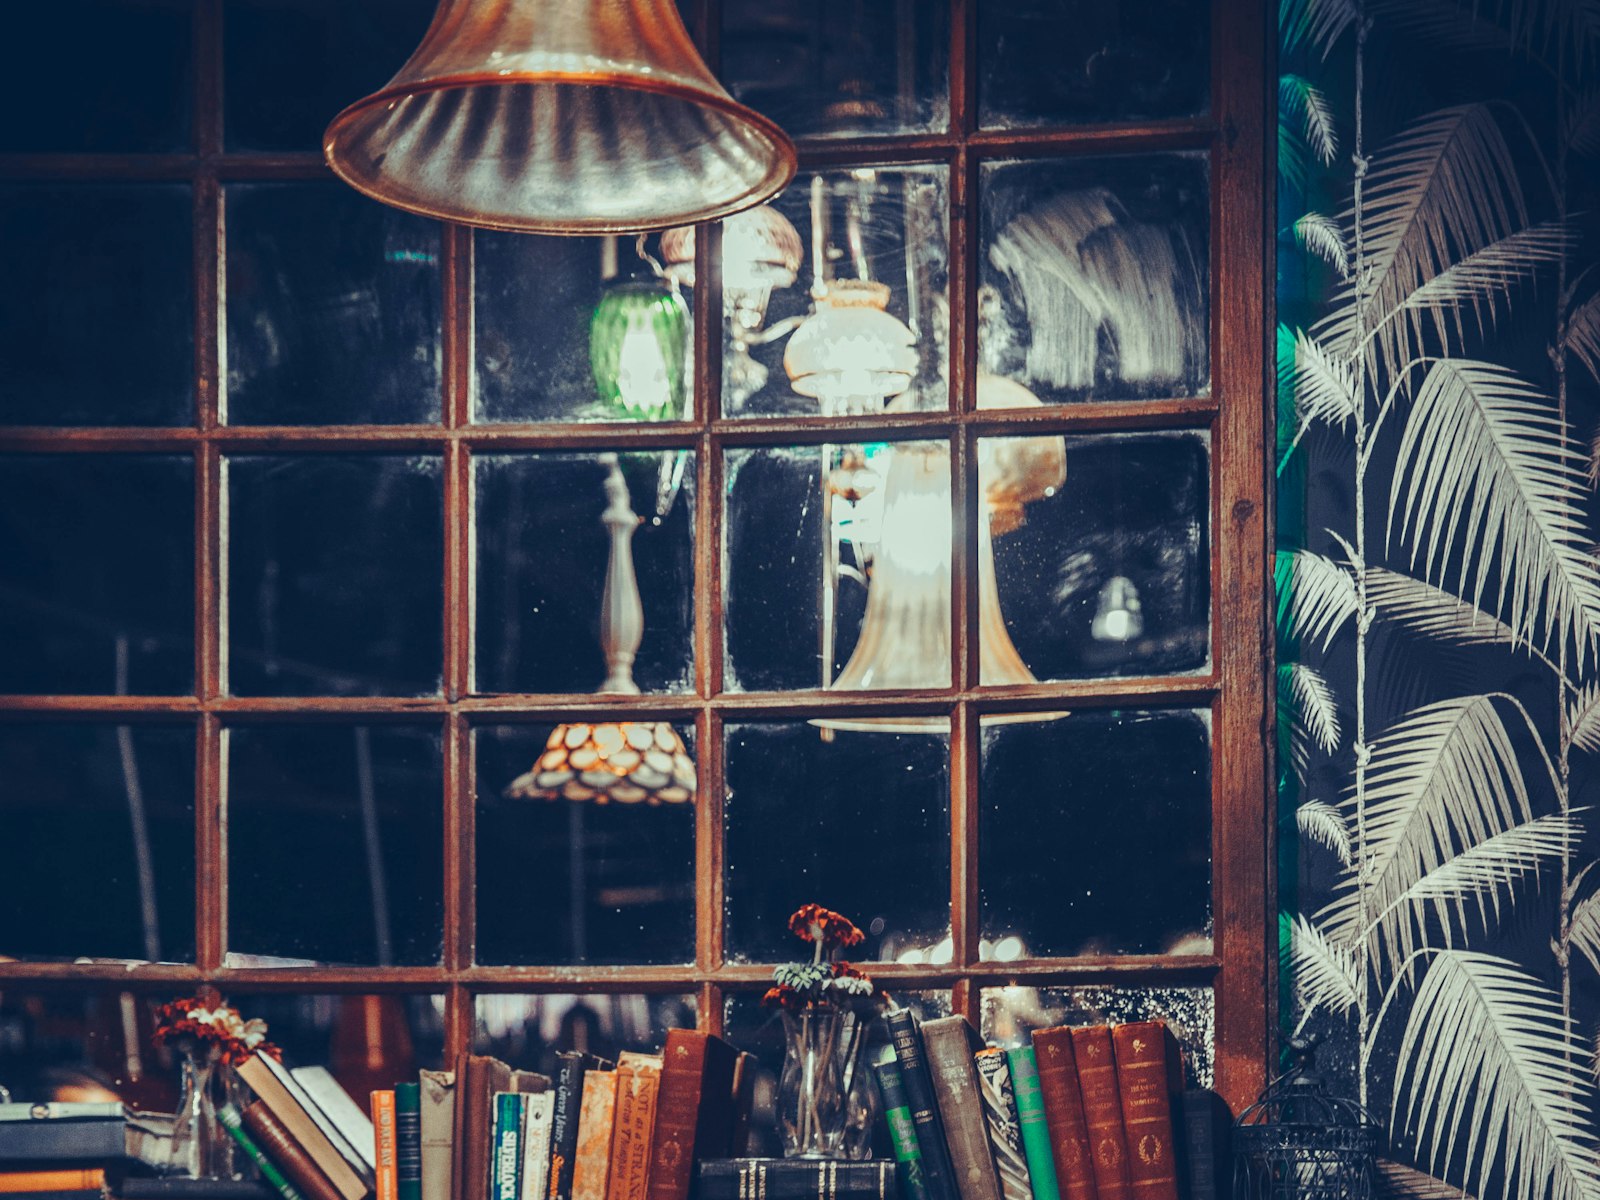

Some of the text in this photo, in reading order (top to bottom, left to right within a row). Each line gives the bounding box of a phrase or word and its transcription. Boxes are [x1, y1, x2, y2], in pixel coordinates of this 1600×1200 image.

[559, 1068, 572, 1085] The
[557, 1085, 571, 1114] Green
[637, 1082, 651, 1114] NOT
[554, 1114, 567, 1142] Years
[634, 1132, 642, 1140] a
[635, 1117, 644, 1129] as
[501, 1130, 517, 1200] SILVERLOCK
